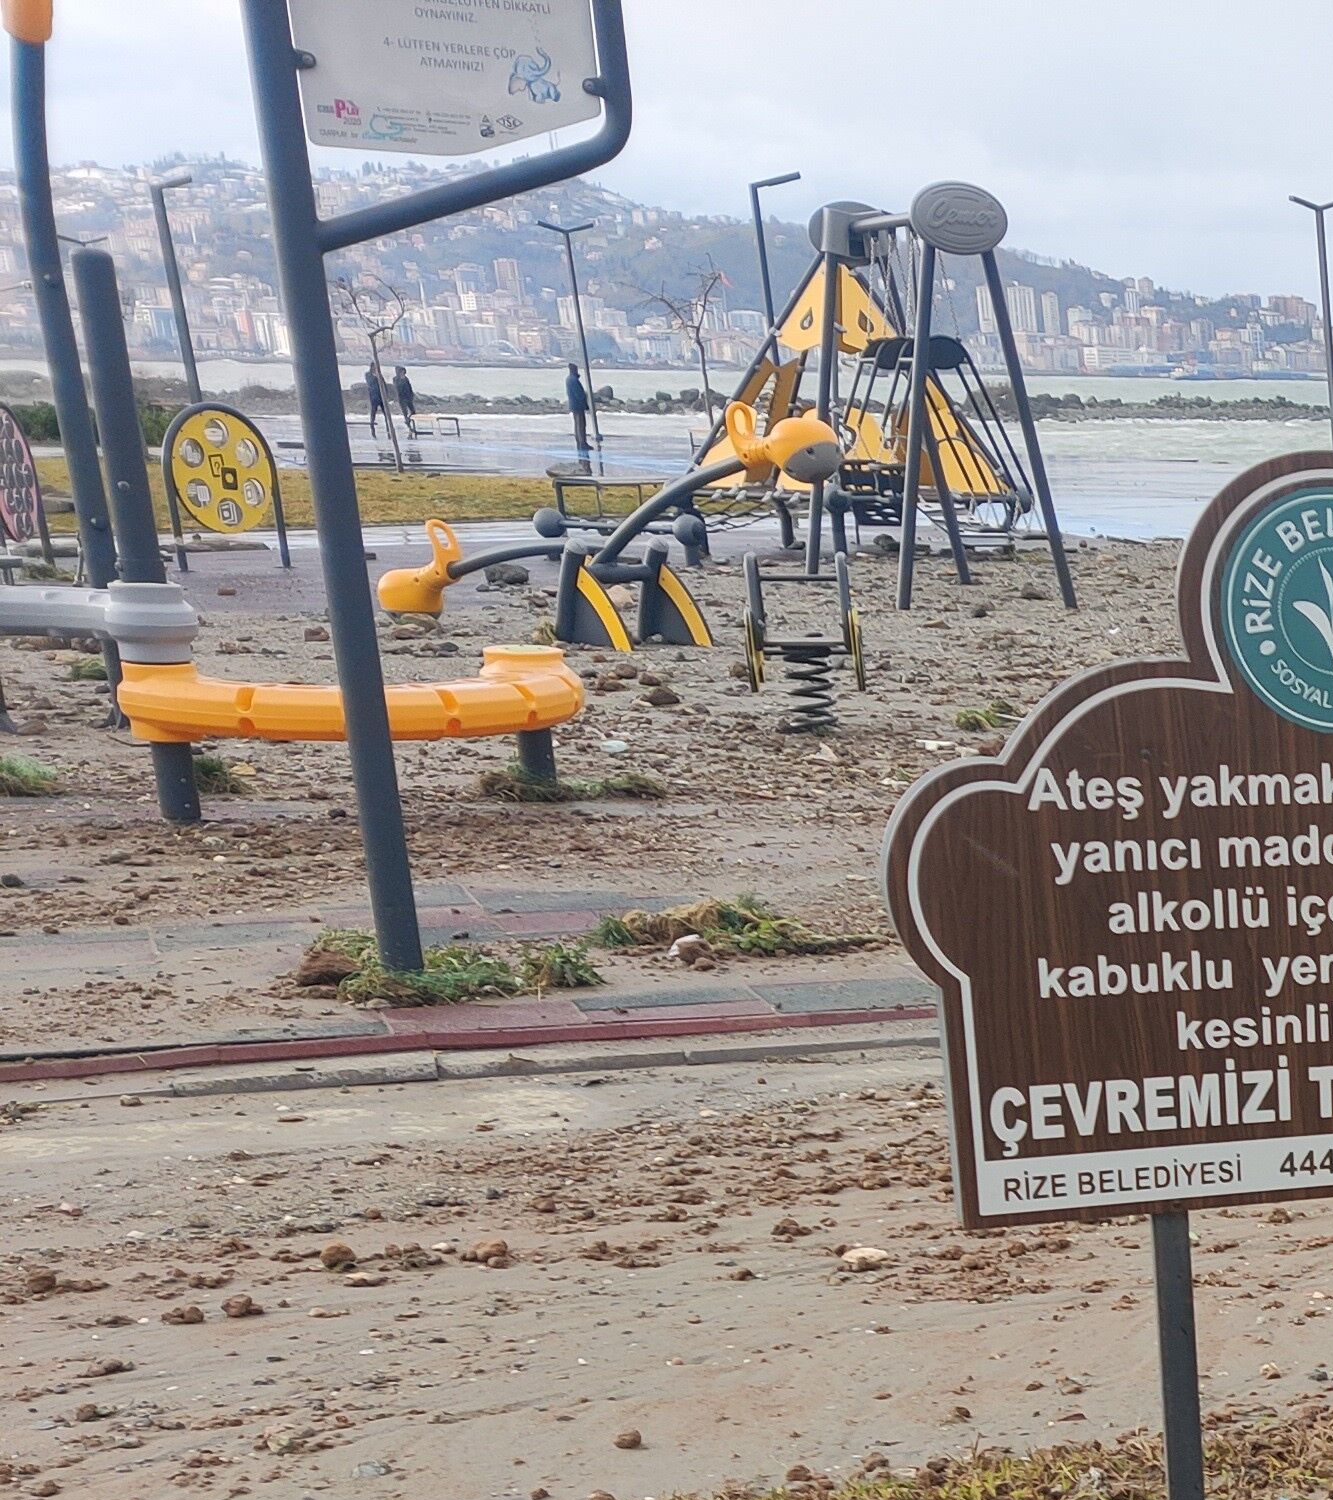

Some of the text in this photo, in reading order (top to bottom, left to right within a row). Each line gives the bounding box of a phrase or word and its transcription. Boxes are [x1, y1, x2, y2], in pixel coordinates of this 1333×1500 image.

[397, 37, 441, 52] LÜTFEN
[442, 42, 490, 57] YERLERE
[492, 44, 516, 60] ÇÖP
[1242, 547, 1284, 635] RİZE
[1270, 658, 1333, 710] SOSYAL
[1027, 767, 1145, 821] Ateş
[1050, 837, 1201, 886] yanıcı
[1107, 886, 1270, 935] alkollü
[1037, 950, 1234, 999] kabuklu
[988, 1054, 1293, 1158] ÇEVREMİZİ
[1003, 1169, 1069, 1202] RİZE
[1077, 1153, 1243, 1196] BELEDİYESİ
